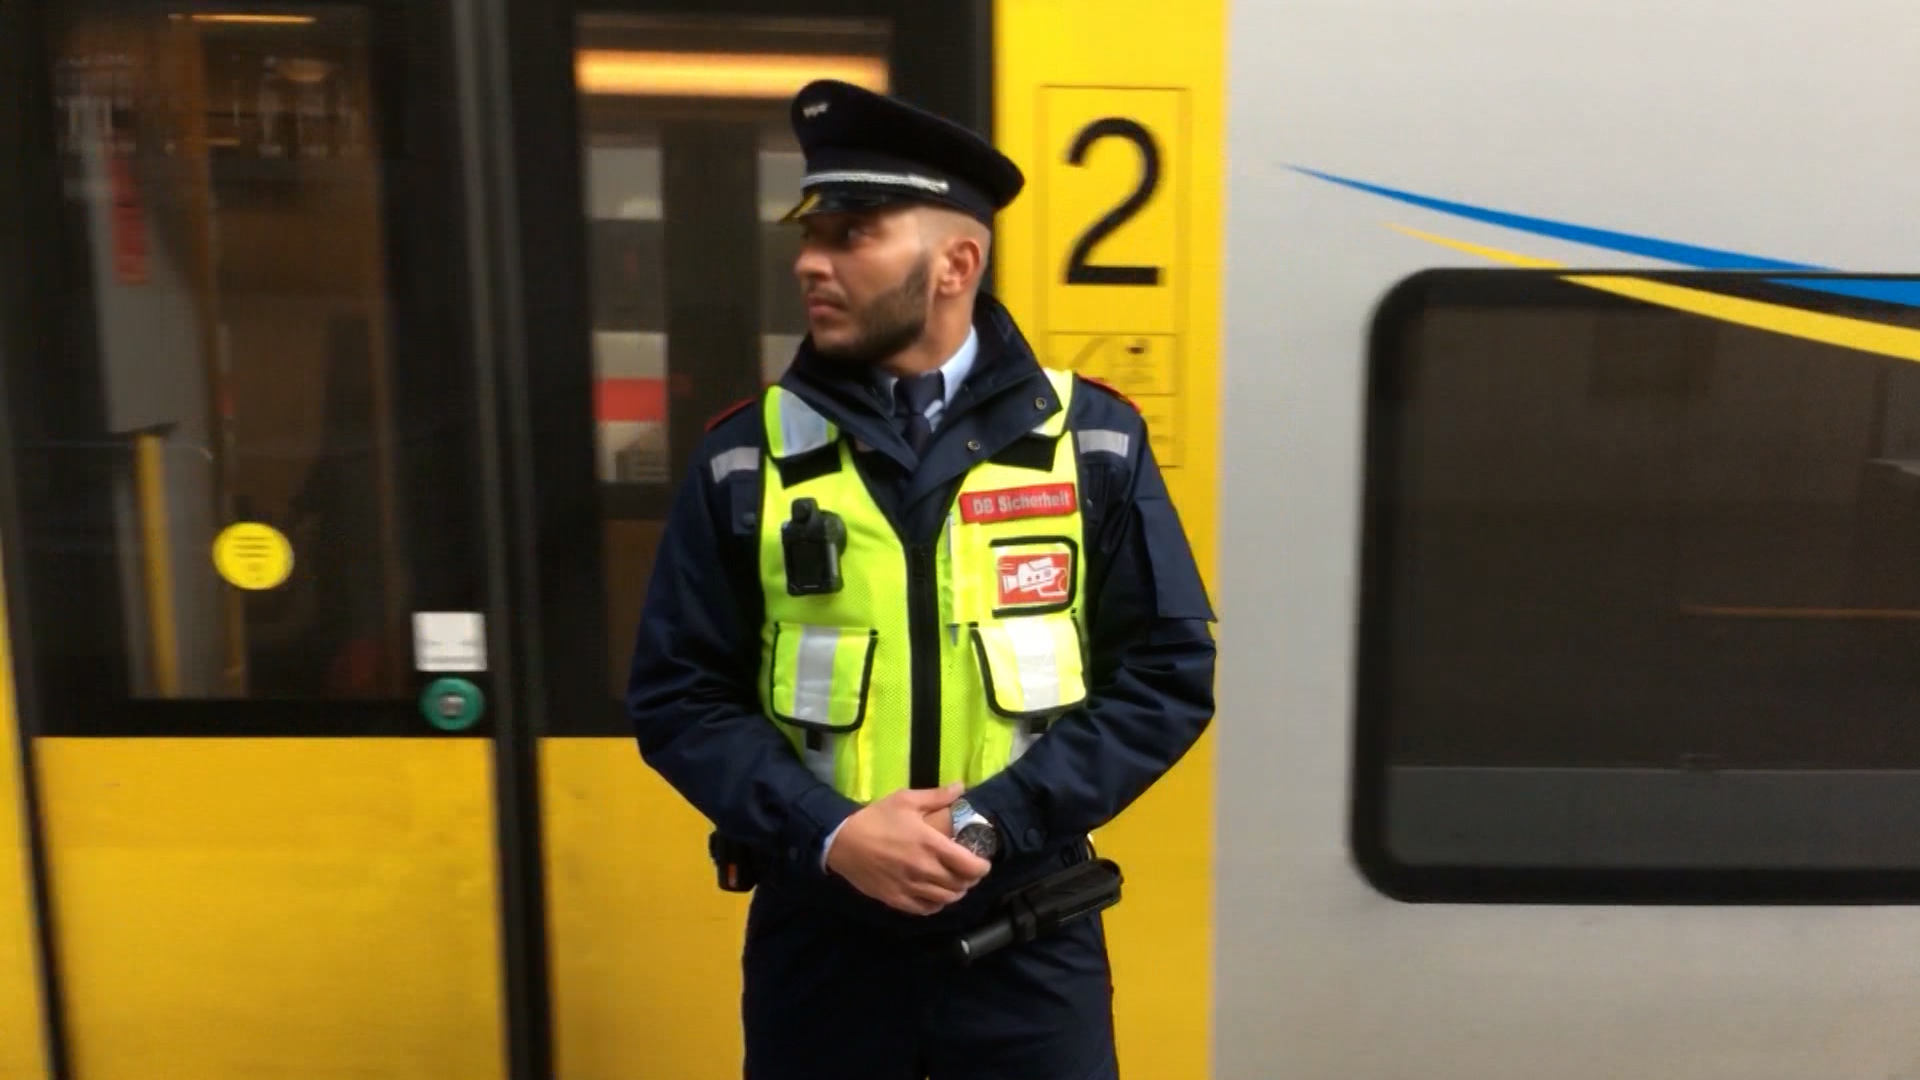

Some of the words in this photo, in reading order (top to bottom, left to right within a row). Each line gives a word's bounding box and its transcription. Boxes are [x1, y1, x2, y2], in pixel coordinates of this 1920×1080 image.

[1065, 117, 1160, 286] 2
[972, 498, 994, 516] DB
[997, 490, 1070, 513] Sicherheit
